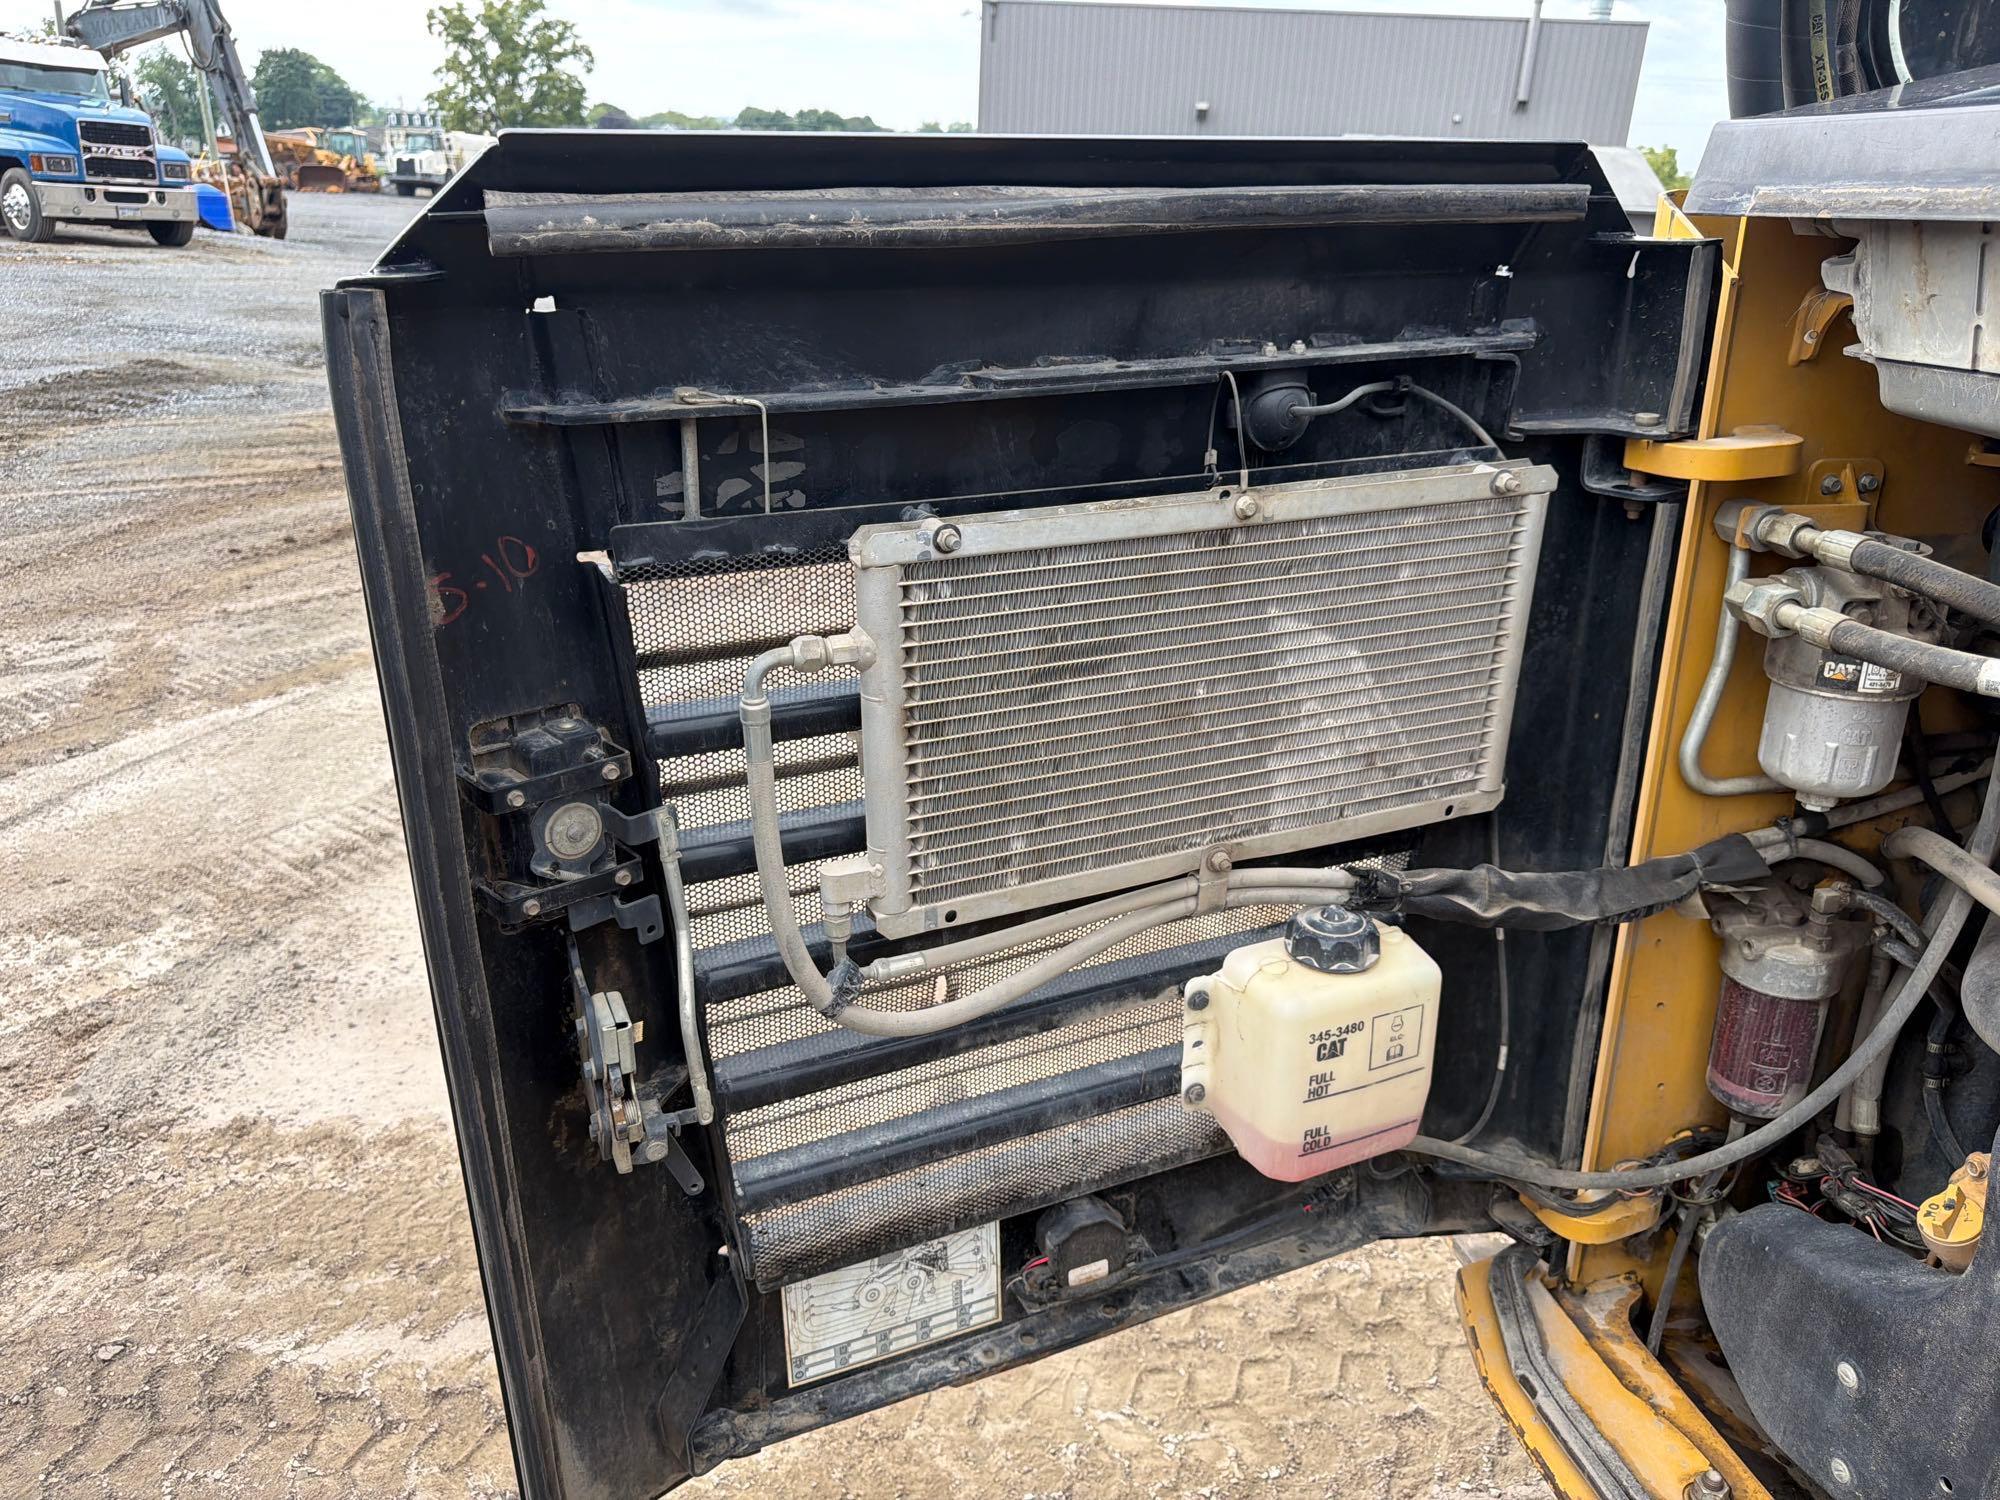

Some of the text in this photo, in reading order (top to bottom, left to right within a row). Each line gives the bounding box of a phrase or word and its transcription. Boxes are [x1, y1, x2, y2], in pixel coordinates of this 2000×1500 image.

[90, 9, 163, 38] MONTAN
[1812, 15, 1829, 101] CAT XT-3ES
[90, 146, 146, 157] MACK
[1823, 661, 1857, 680] CAT
[1309, 1021, 1365, 1045] 345-3480
[1316, 1038, 1348, 1062] CAT
[1309, 1071, 1336, 1087] FULL
[1307, 1083, 1331, 1099] HOT
[1304, 1125, 1330, 1141] FULL
[1303, 1136, 1331, 1153] COLD
